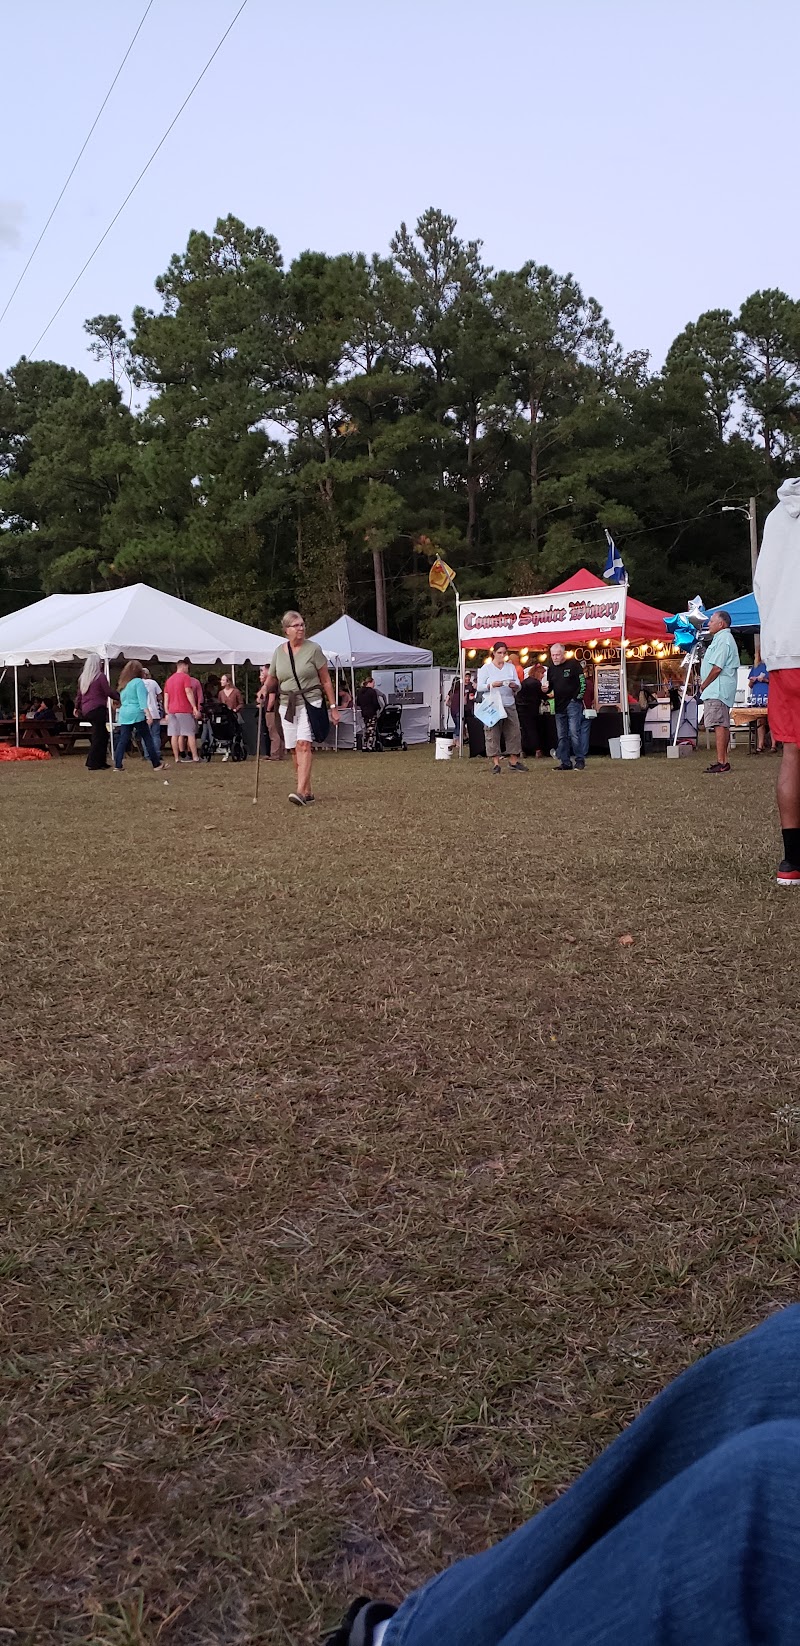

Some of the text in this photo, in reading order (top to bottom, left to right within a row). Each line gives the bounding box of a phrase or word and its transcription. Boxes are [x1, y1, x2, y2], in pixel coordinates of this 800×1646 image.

[463, 601, 619, 630] Country Squire Winery
